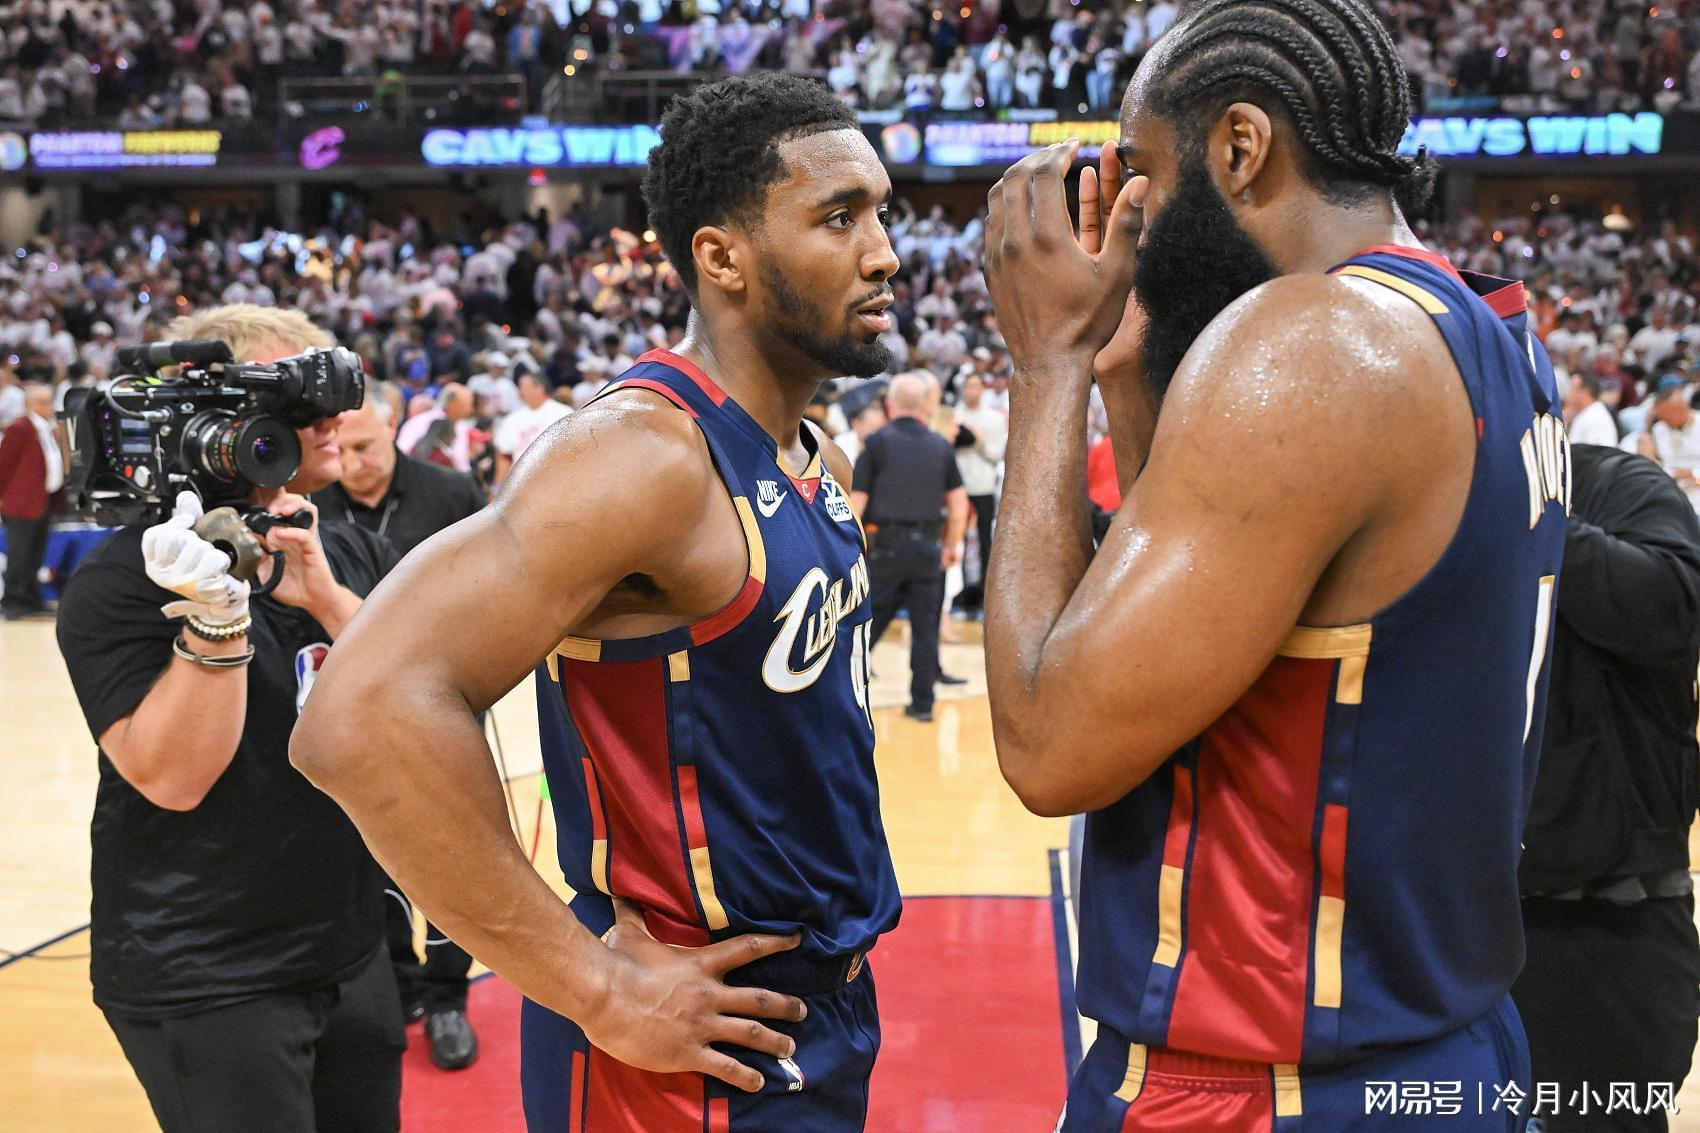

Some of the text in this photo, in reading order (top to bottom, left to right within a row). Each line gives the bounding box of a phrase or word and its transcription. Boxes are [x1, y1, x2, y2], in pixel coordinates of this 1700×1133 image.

[421, 127, 563, 164] CAVS
[1396, 111, 1663, 155] AVS WIN
[756, 479, 779, 501] NIKE
